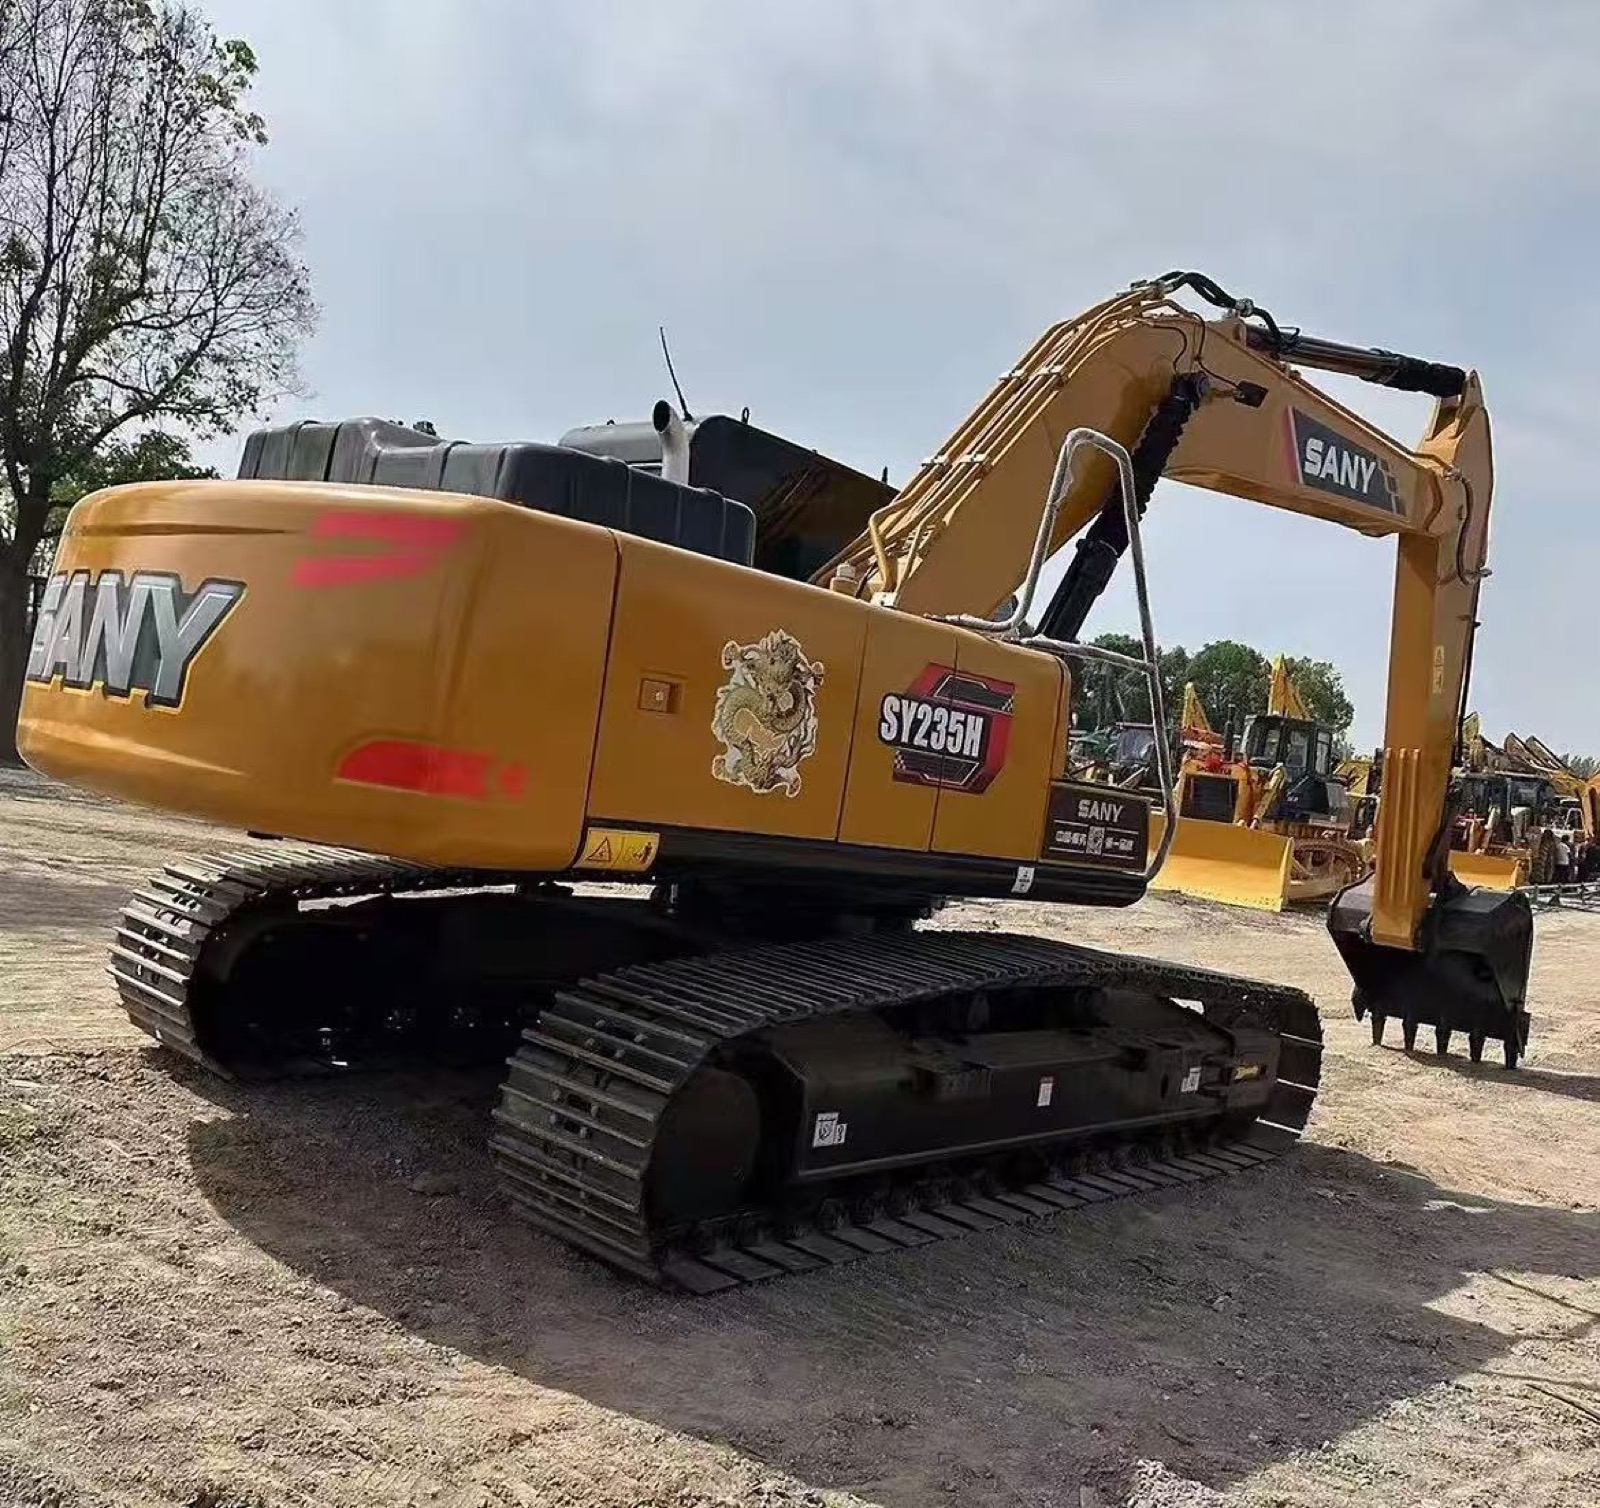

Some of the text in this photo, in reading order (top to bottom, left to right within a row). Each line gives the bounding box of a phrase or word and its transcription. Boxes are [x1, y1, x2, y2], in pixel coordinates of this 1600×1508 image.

[1304, 437, 1376, 494] SANY
[880, 695, 984, 757] SY235H
[1078, 799, 1124, 822] SANY
